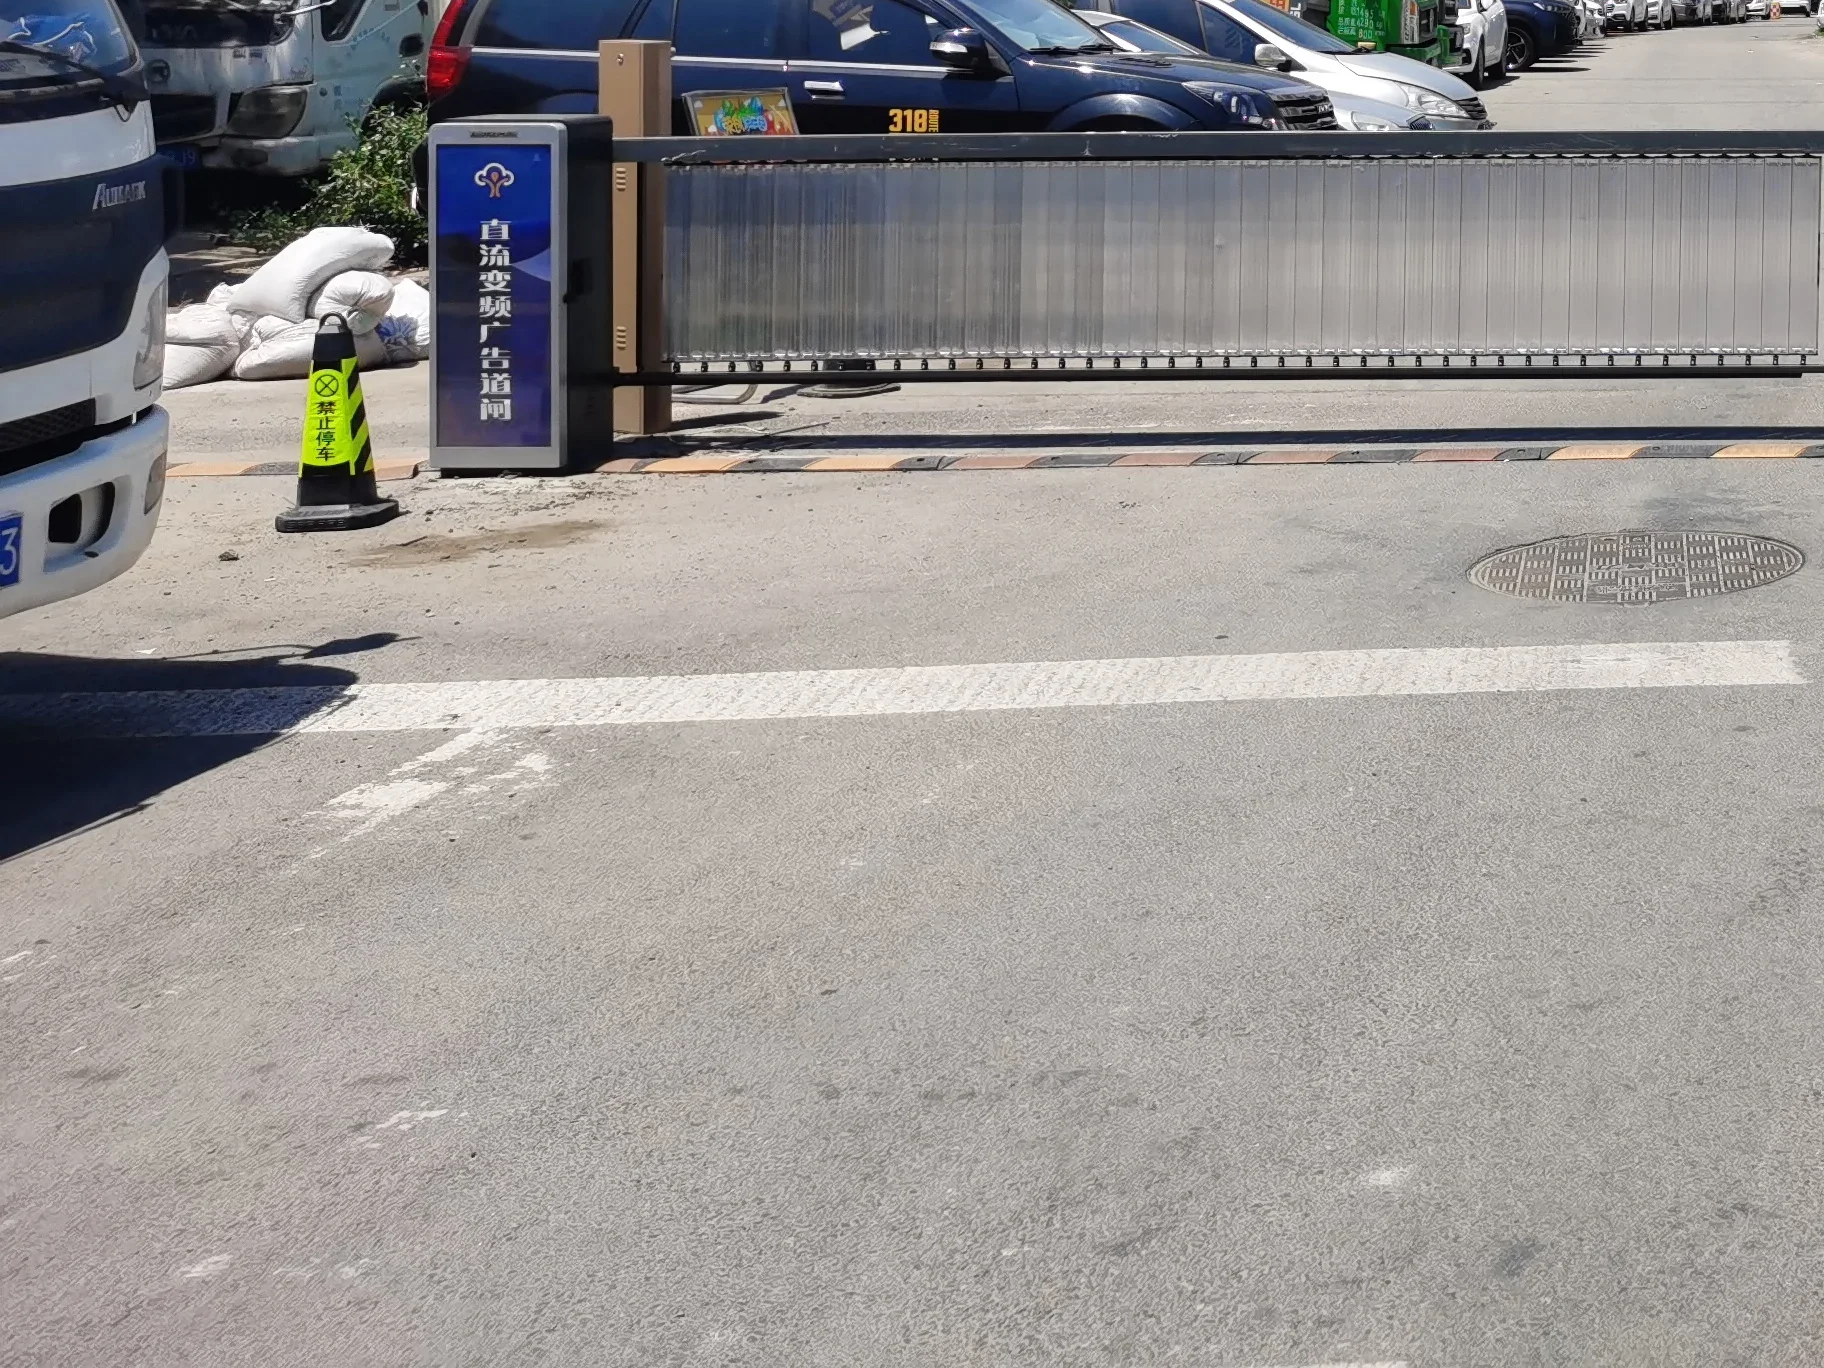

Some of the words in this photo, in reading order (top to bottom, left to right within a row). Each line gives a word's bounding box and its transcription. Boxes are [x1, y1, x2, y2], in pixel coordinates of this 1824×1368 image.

[888, 108, 928, 132] 318
[478, 218, 513, 421] 直流变频广告道闸
[315, 400, 337, 462] 禁止停车
